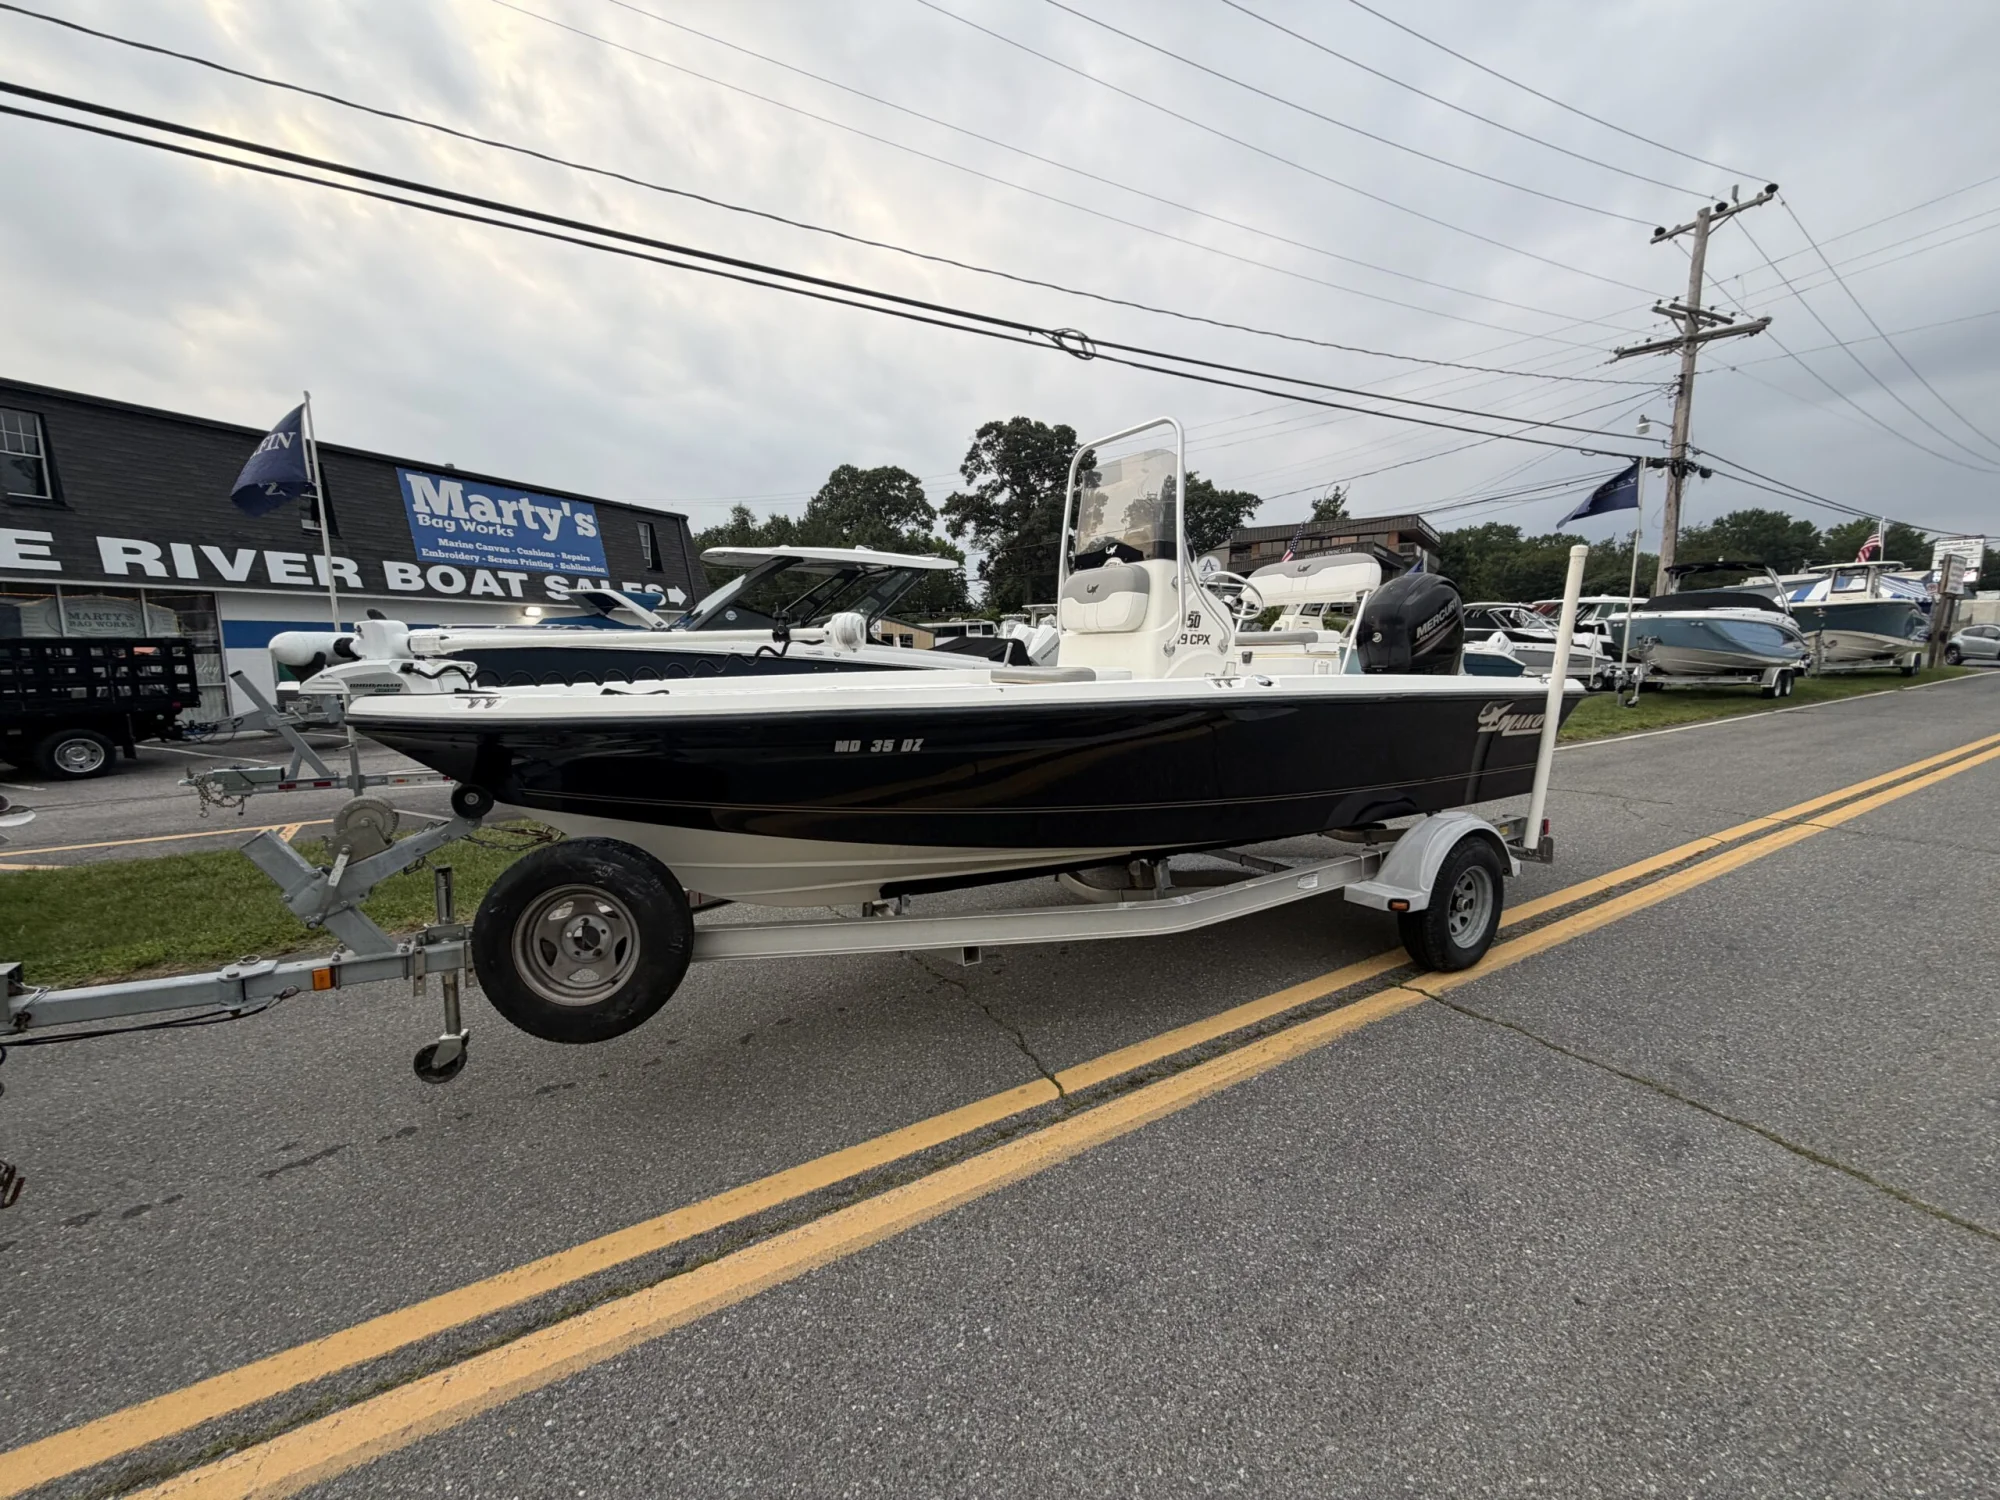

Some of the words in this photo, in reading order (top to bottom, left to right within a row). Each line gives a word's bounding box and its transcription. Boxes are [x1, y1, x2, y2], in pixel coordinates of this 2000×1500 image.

[250, 432, 296, 459] FIN
[405, 473, 597, 541] Marty's
[416, 513, 456, 532] Bag
[459, 519, 515, 537] Works
[420, 548, 480, 563] Embroidery
[487, 555, 519, 565] Screen
[519, 558, 554, 569] Printing
[559, 562, 606, 573] Sublimation
[437, 537, 474, 550] Marine
[475, 542, 510, 553] Canvas
[516, 547, 556, 558] Cushions
[560, 552, 591, 562] Repairs
[95, 536, 364, 589] RIVER
[382, 560, 529, 598] BOAT
[67, 611, 135, 621] MARTY'S
[96, 620, 136, 628] WORKS
[1186, 614, 1201, 628] 50
[1190, 634, 1211, 645] CPX
[1498, 713, 1545, 736] MAKO
[834, 740, 861, 752] MD
[870, 739, 895, 752] 35
